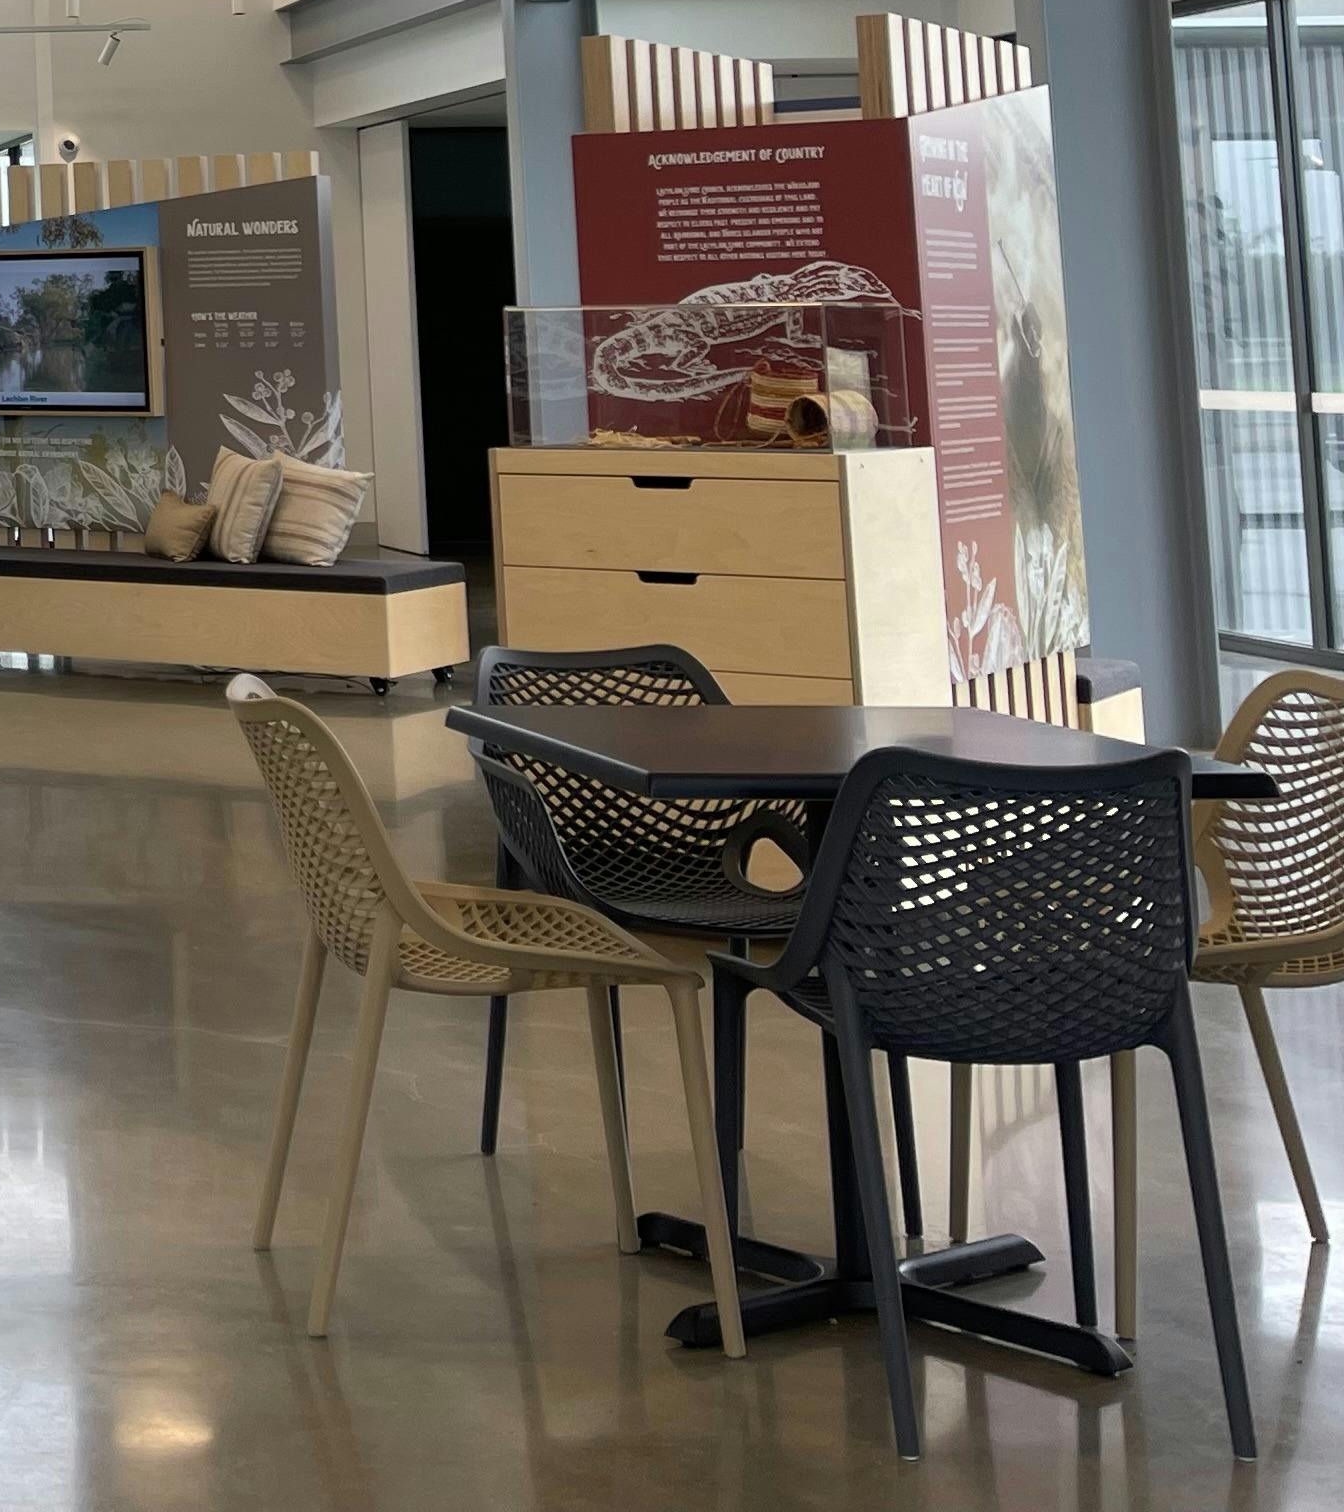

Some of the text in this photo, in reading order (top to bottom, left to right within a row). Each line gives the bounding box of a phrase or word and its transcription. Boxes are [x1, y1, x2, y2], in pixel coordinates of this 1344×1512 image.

[648, 146, 825, 170] ACKNOWLEDGEMENT OF COUNTRY
[186, 218, 299, 237] NATURAL WONDERS
